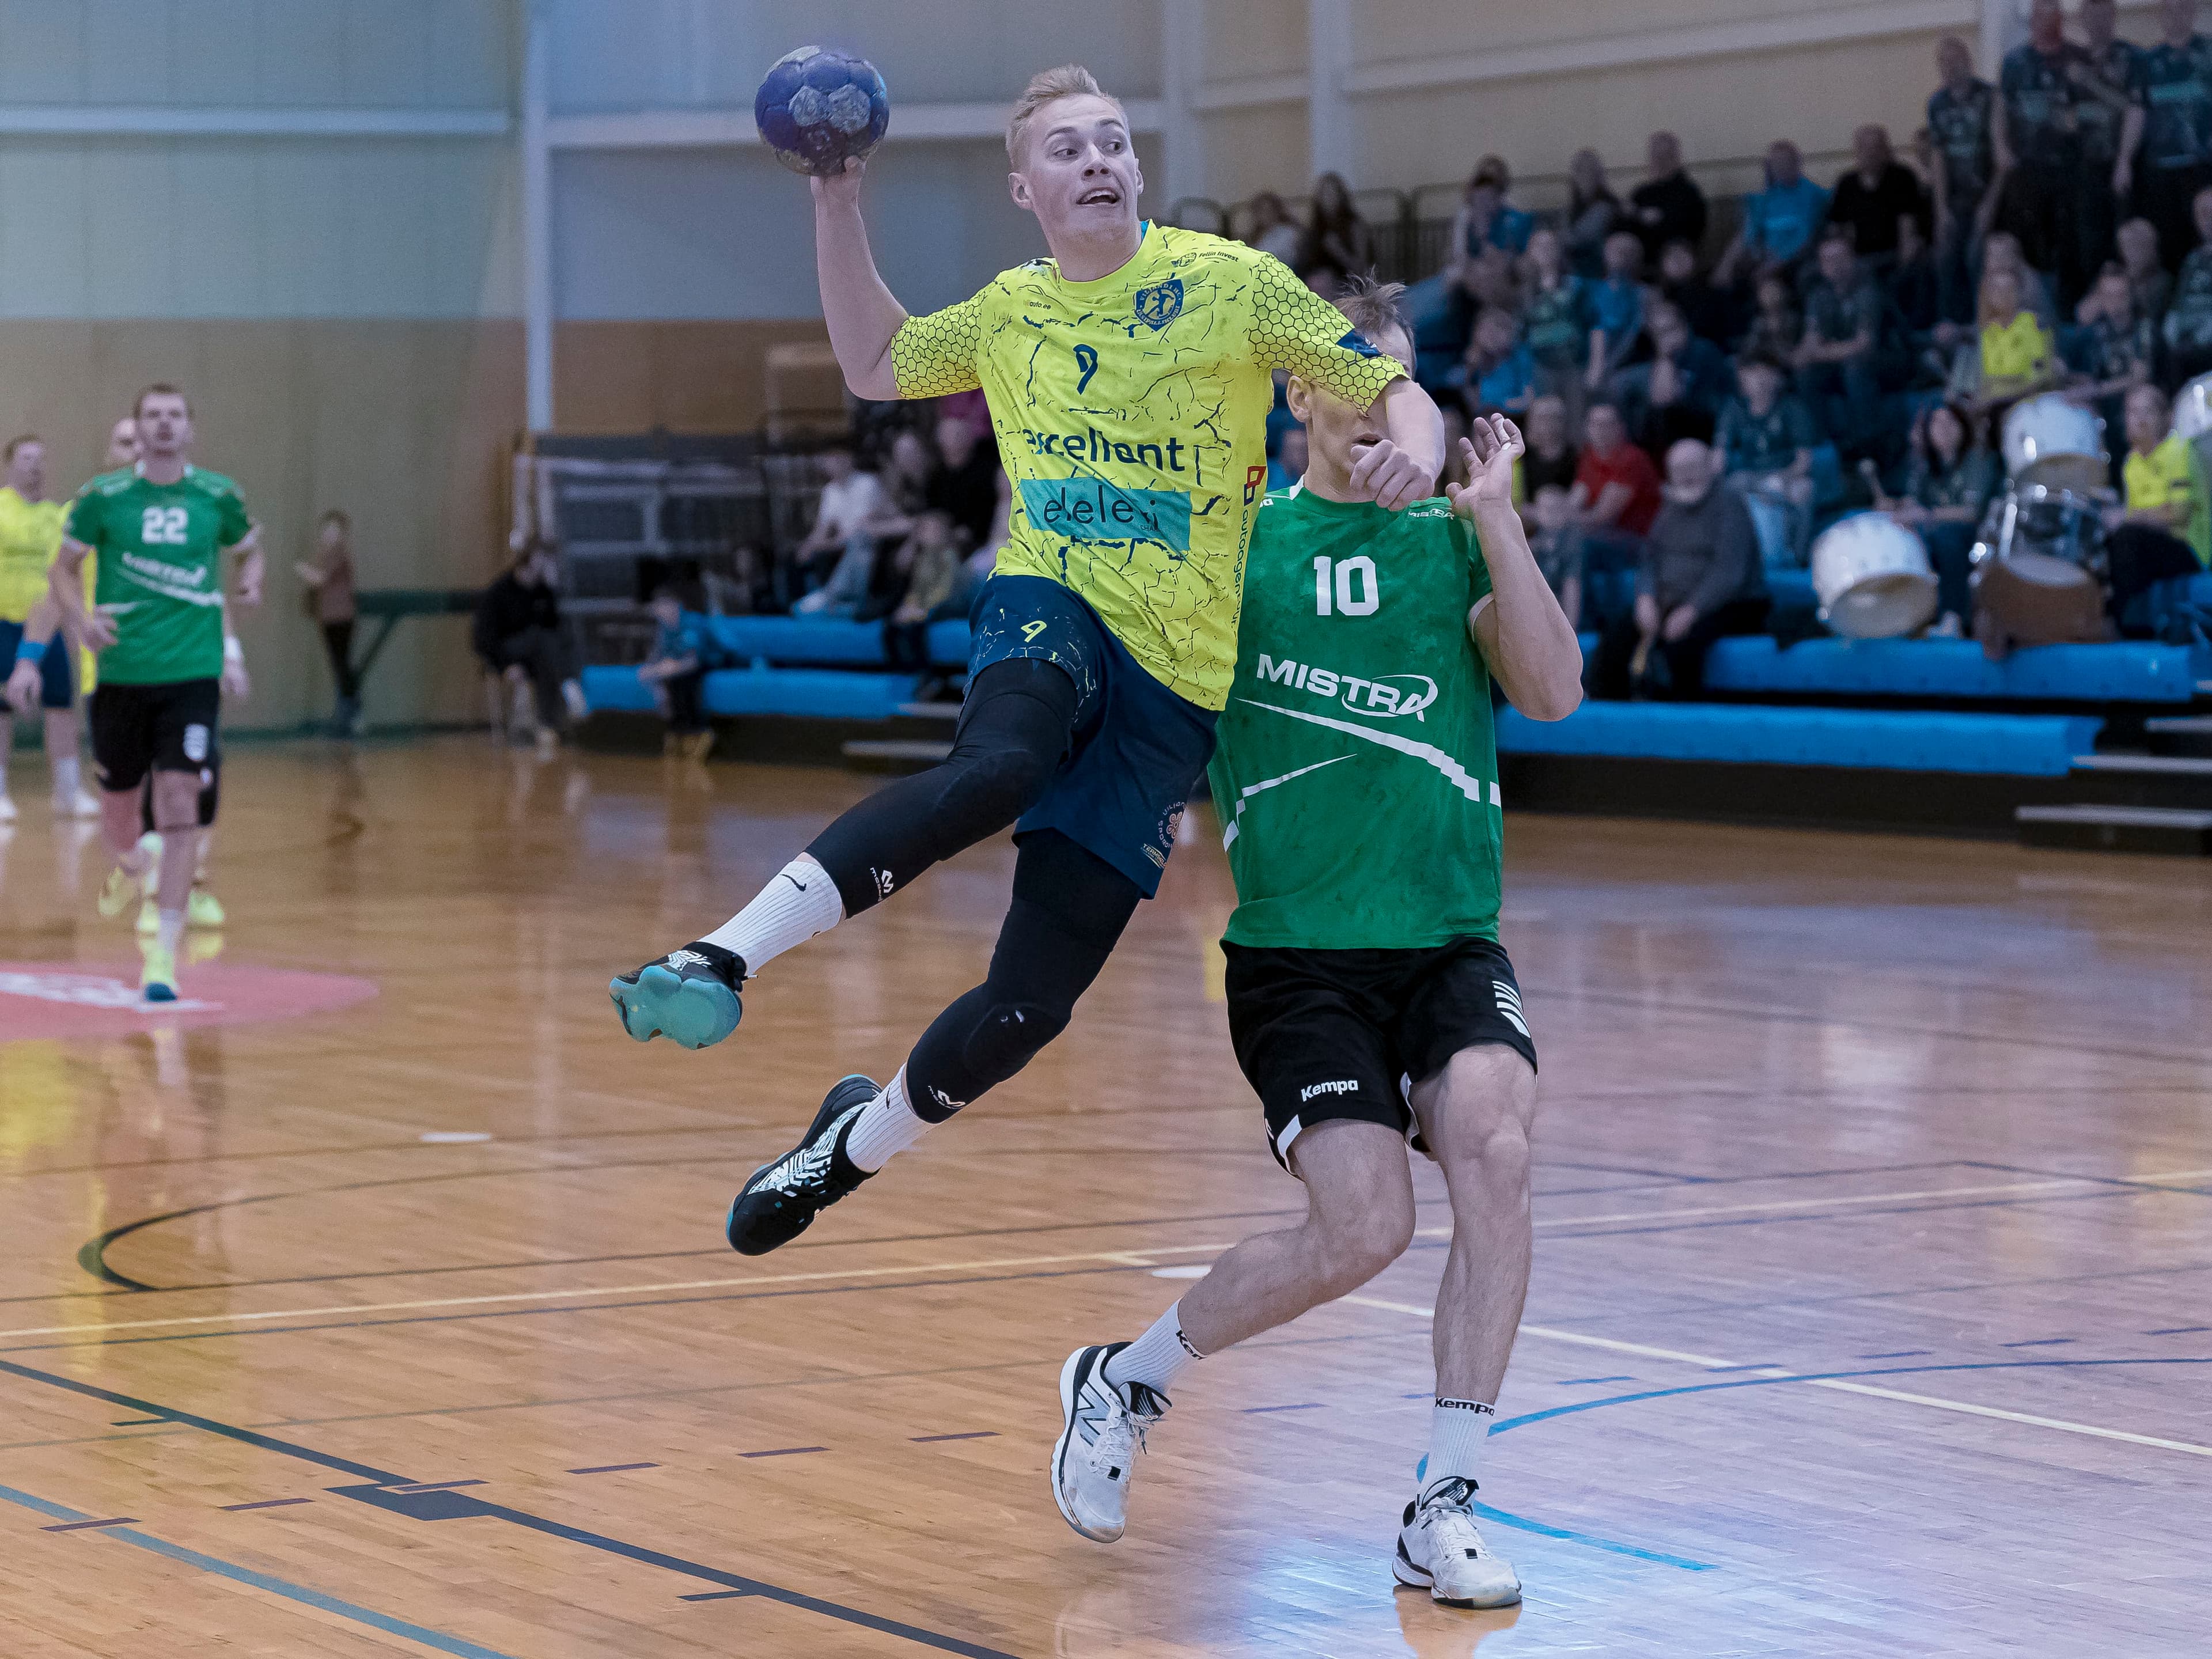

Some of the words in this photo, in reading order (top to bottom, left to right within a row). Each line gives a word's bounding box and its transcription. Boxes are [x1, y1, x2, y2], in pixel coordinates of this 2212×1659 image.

[1217, 251, 1239, 262] Invest
[1073, 344, 1099, 395] 9
[142, 506, 188, 544] 22
[1313, 555, 1380, 616] 10
[1020, 620, 1047, 643] 9
[1256, 653, 1426, 722] MISTRA
[1301, 1080, 1358, 1102] Kempa
